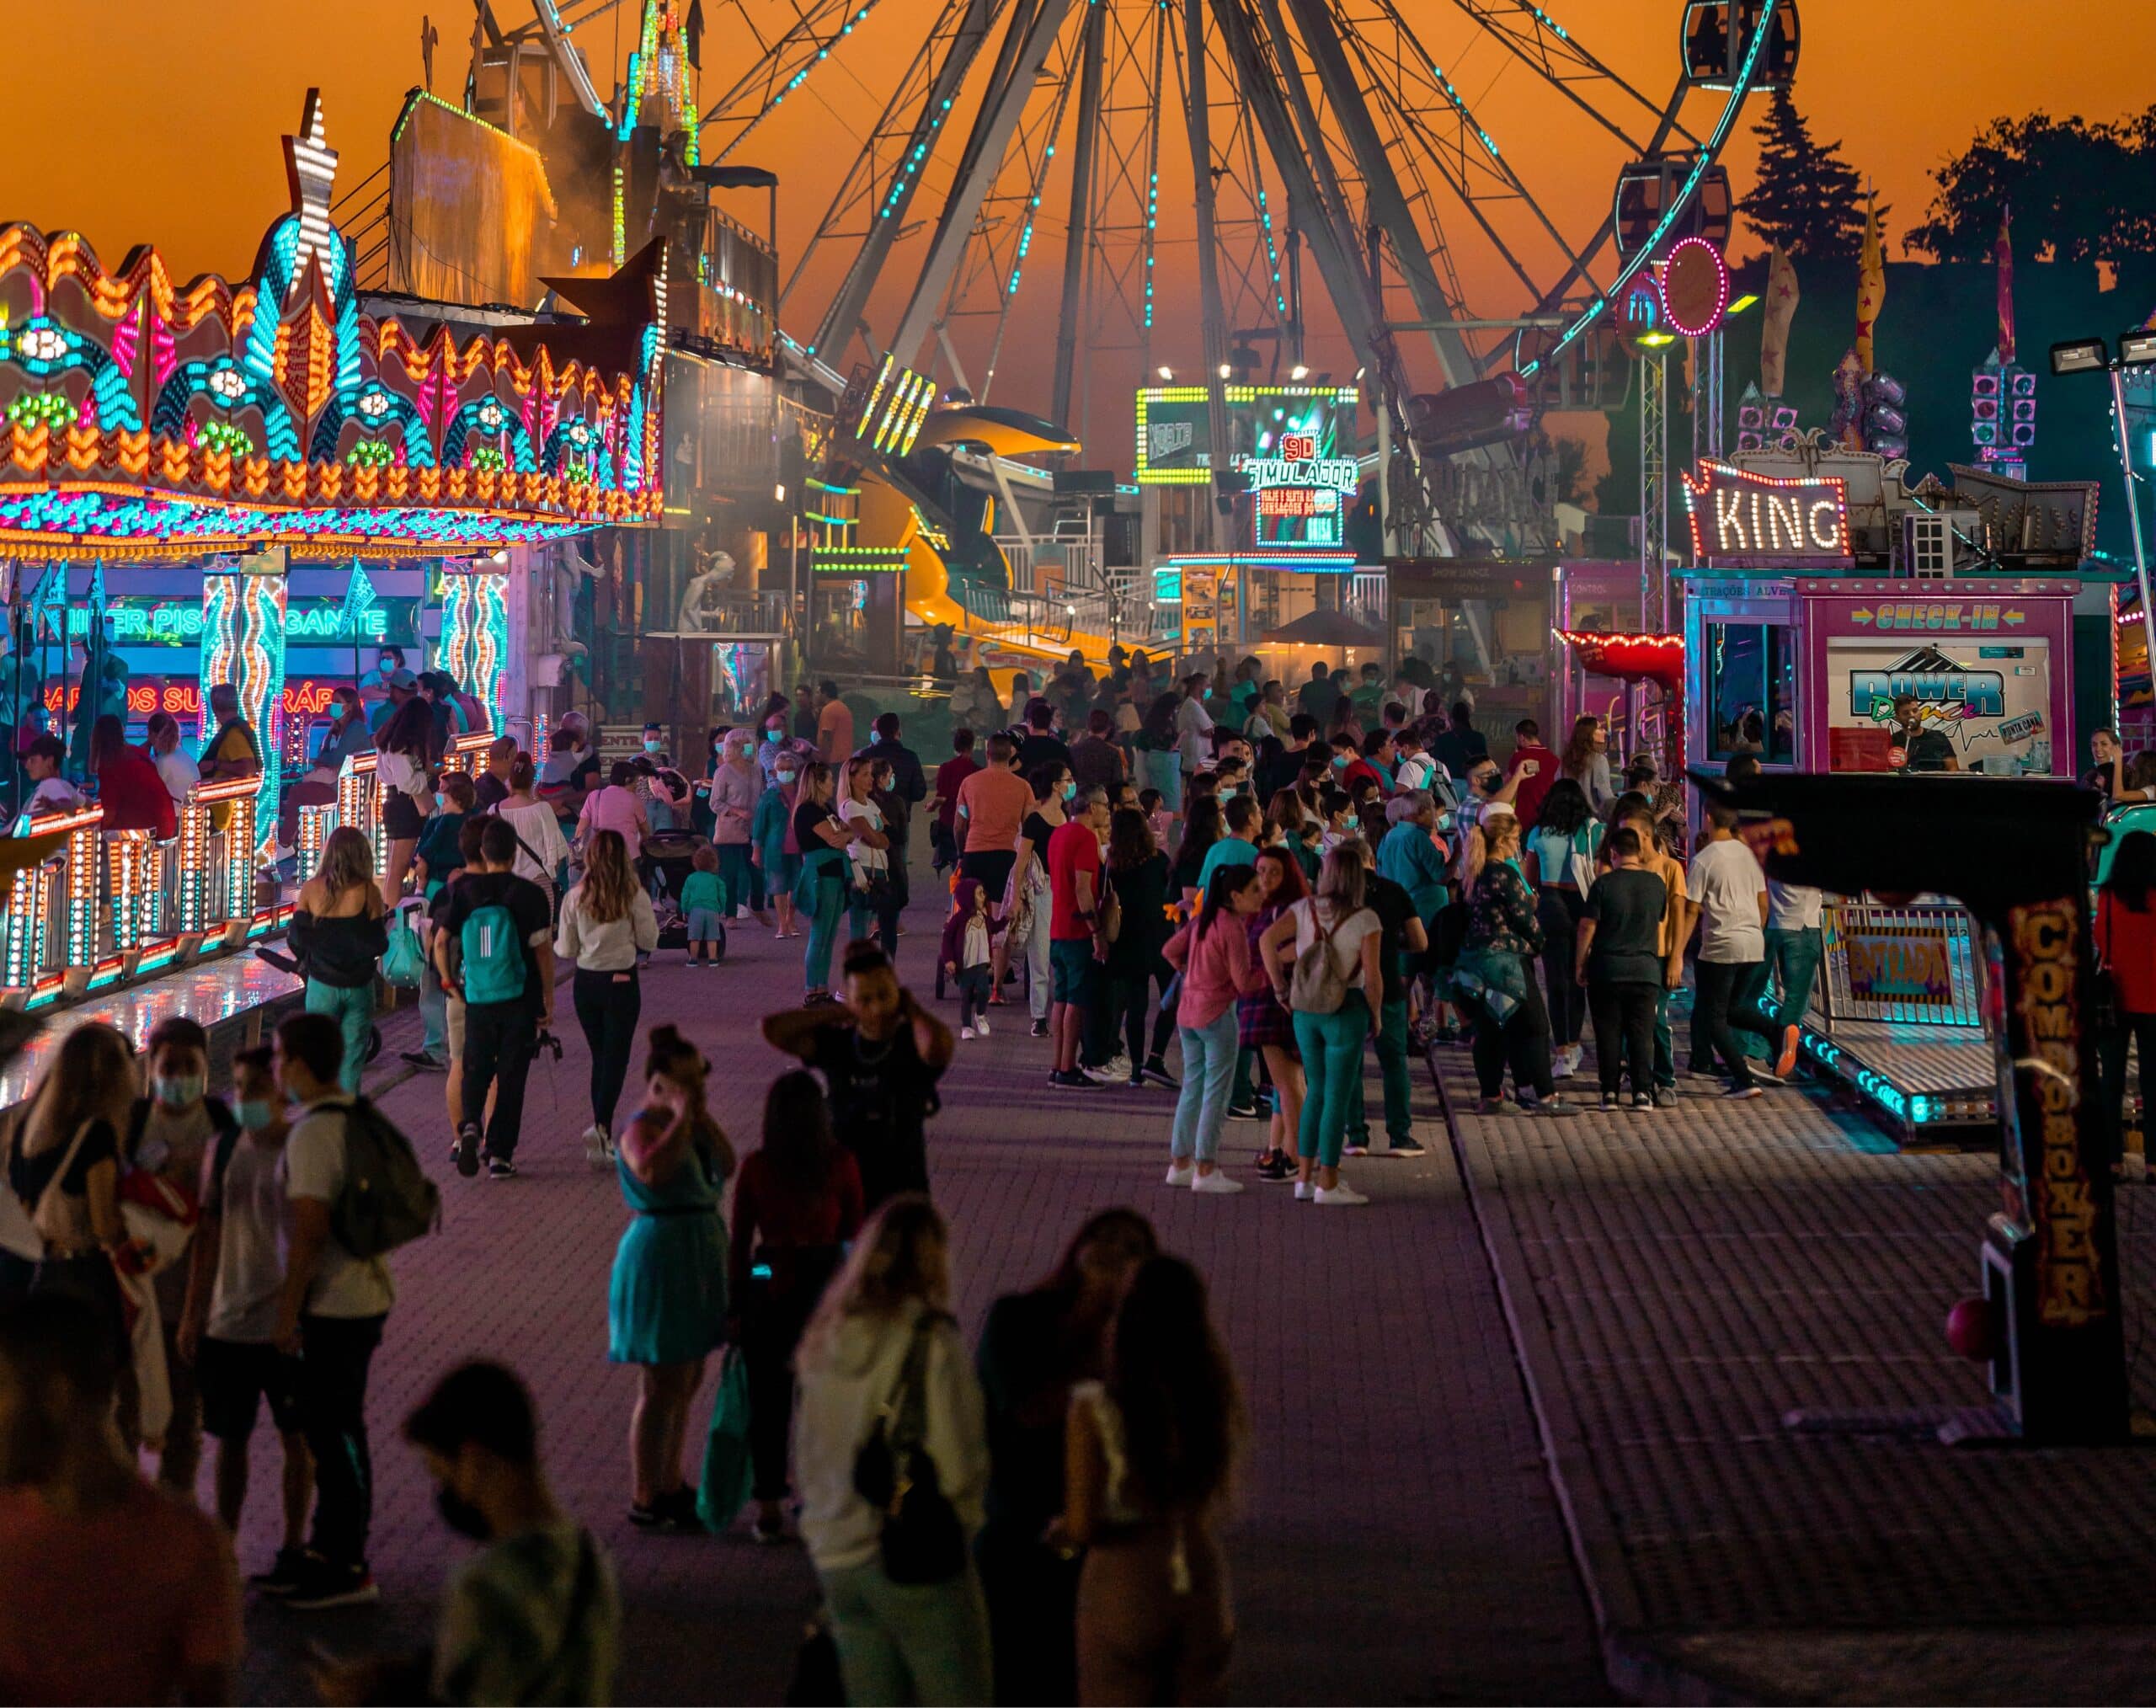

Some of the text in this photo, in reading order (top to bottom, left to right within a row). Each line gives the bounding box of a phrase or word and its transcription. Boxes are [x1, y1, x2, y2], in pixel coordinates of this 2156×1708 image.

[1283, 435, 1315, 462] 9D
[1248, 461, 1355, 493] SIMULADOR
[1716, 488, 1839, 550] KING
[1876, 604, 2000, 629] CHECK-IN
[163, 687, 202, 712] SU
[1853, 672, 2003, 715] POWER
[1871, 695, 1982, 723] Dnce
[601, 735, 671, 746] ENTRA
[1853, 940, 1948, 985] ENTRADA
